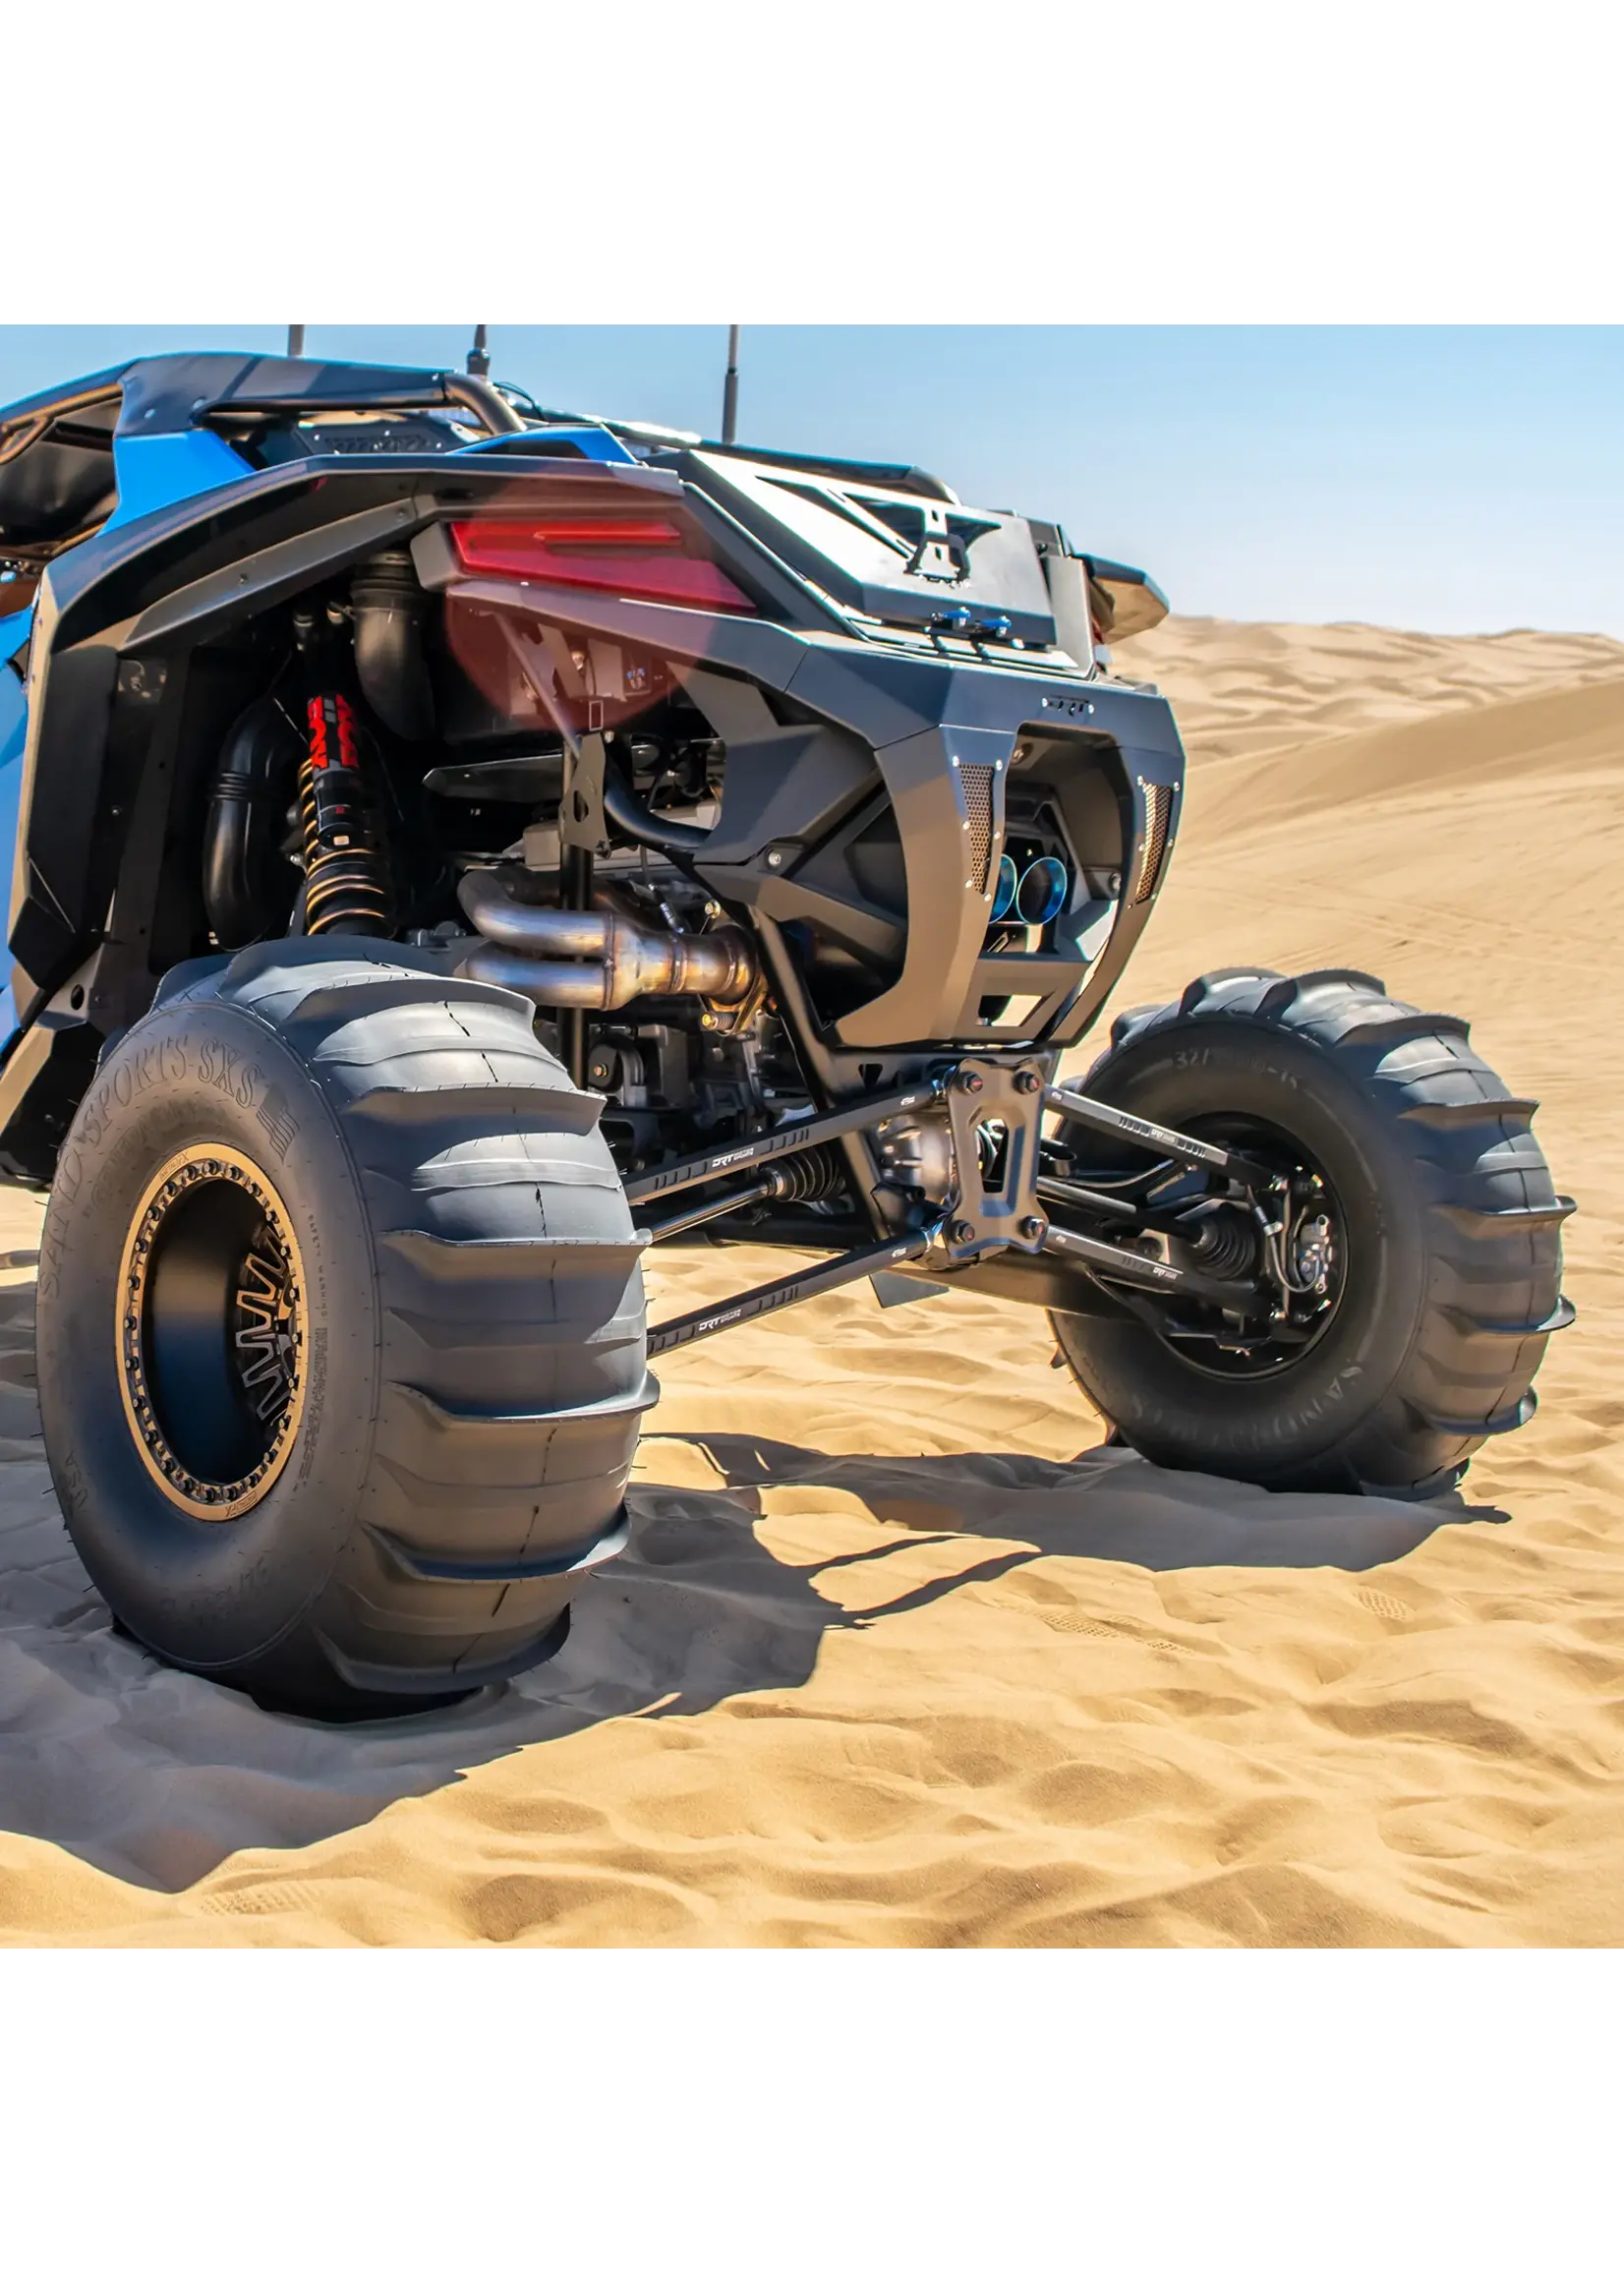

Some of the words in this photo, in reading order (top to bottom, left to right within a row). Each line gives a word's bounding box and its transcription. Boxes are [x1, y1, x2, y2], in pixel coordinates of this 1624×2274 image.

[42, 1148, 83, 1298] SAND
[83, 1033, 189, 1148] SPORTS
[198, 1037, 266, 1109] SXS
